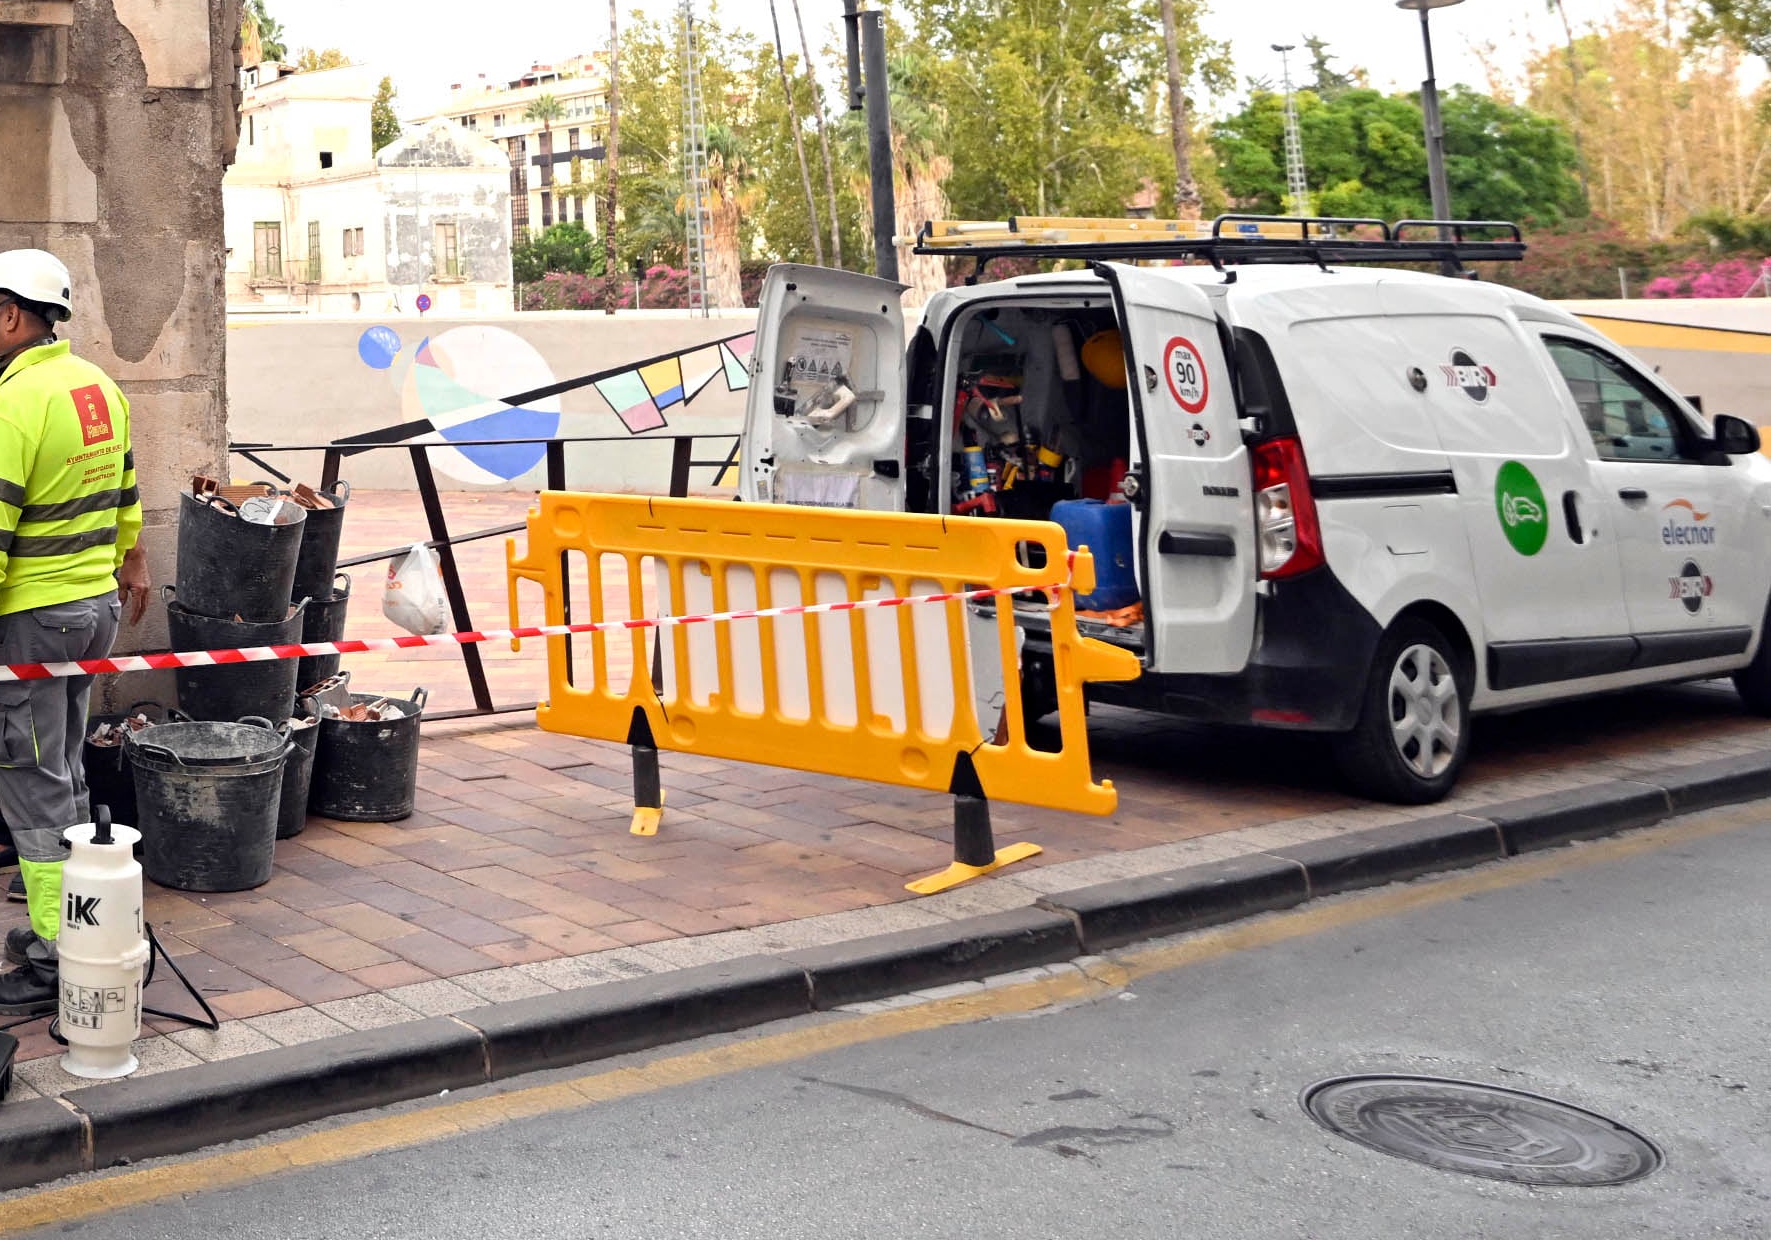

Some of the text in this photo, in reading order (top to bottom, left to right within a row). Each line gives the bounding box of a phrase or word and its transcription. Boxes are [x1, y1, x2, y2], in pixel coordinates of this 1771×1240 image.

[1175, 350, 1192, 361] max
[1176, 362, 1196, 385] 90
[1180, 387, 1200, 399] km/h
[1662, 519, 1716, 545] elecnor
